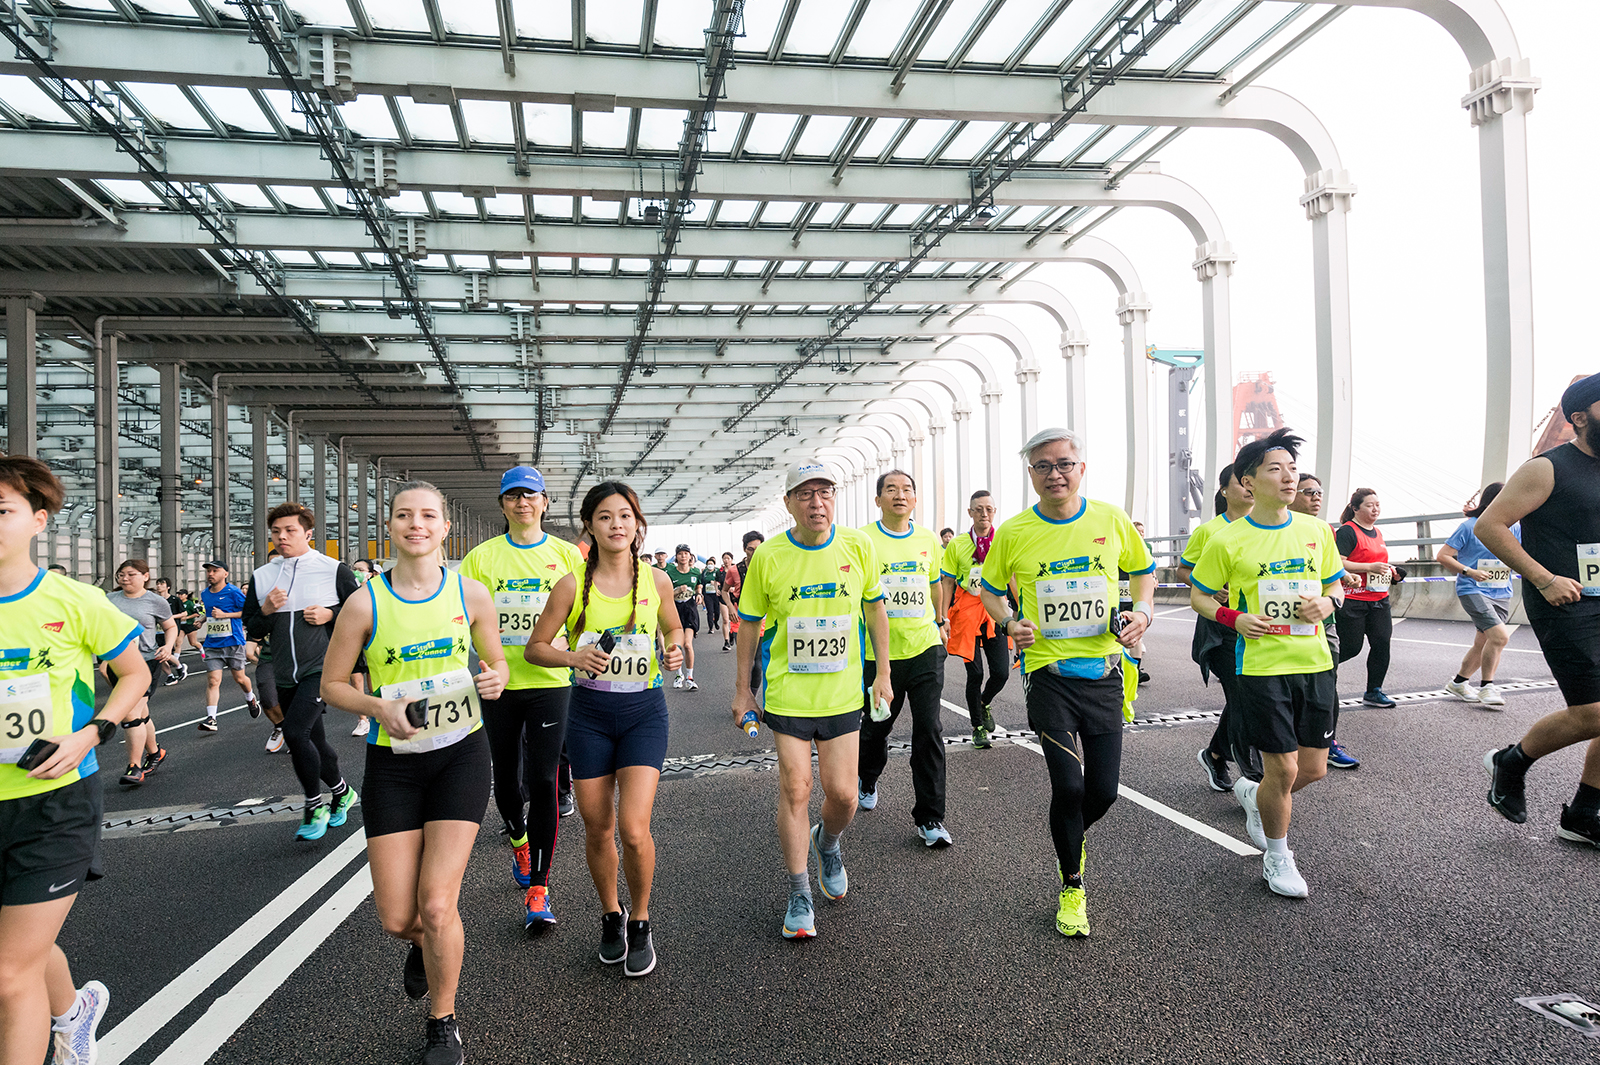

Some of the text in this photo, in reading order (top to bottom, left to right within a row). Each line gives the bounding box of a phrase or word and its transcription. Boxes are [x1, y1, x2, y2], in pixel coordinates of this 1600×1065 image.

[1043, 599, 1105, 622] P2076
[1264, 601, 1302, 619] G35
[207, 624, 230, 632] P4921
[793, 636, 846, 657] P1239
